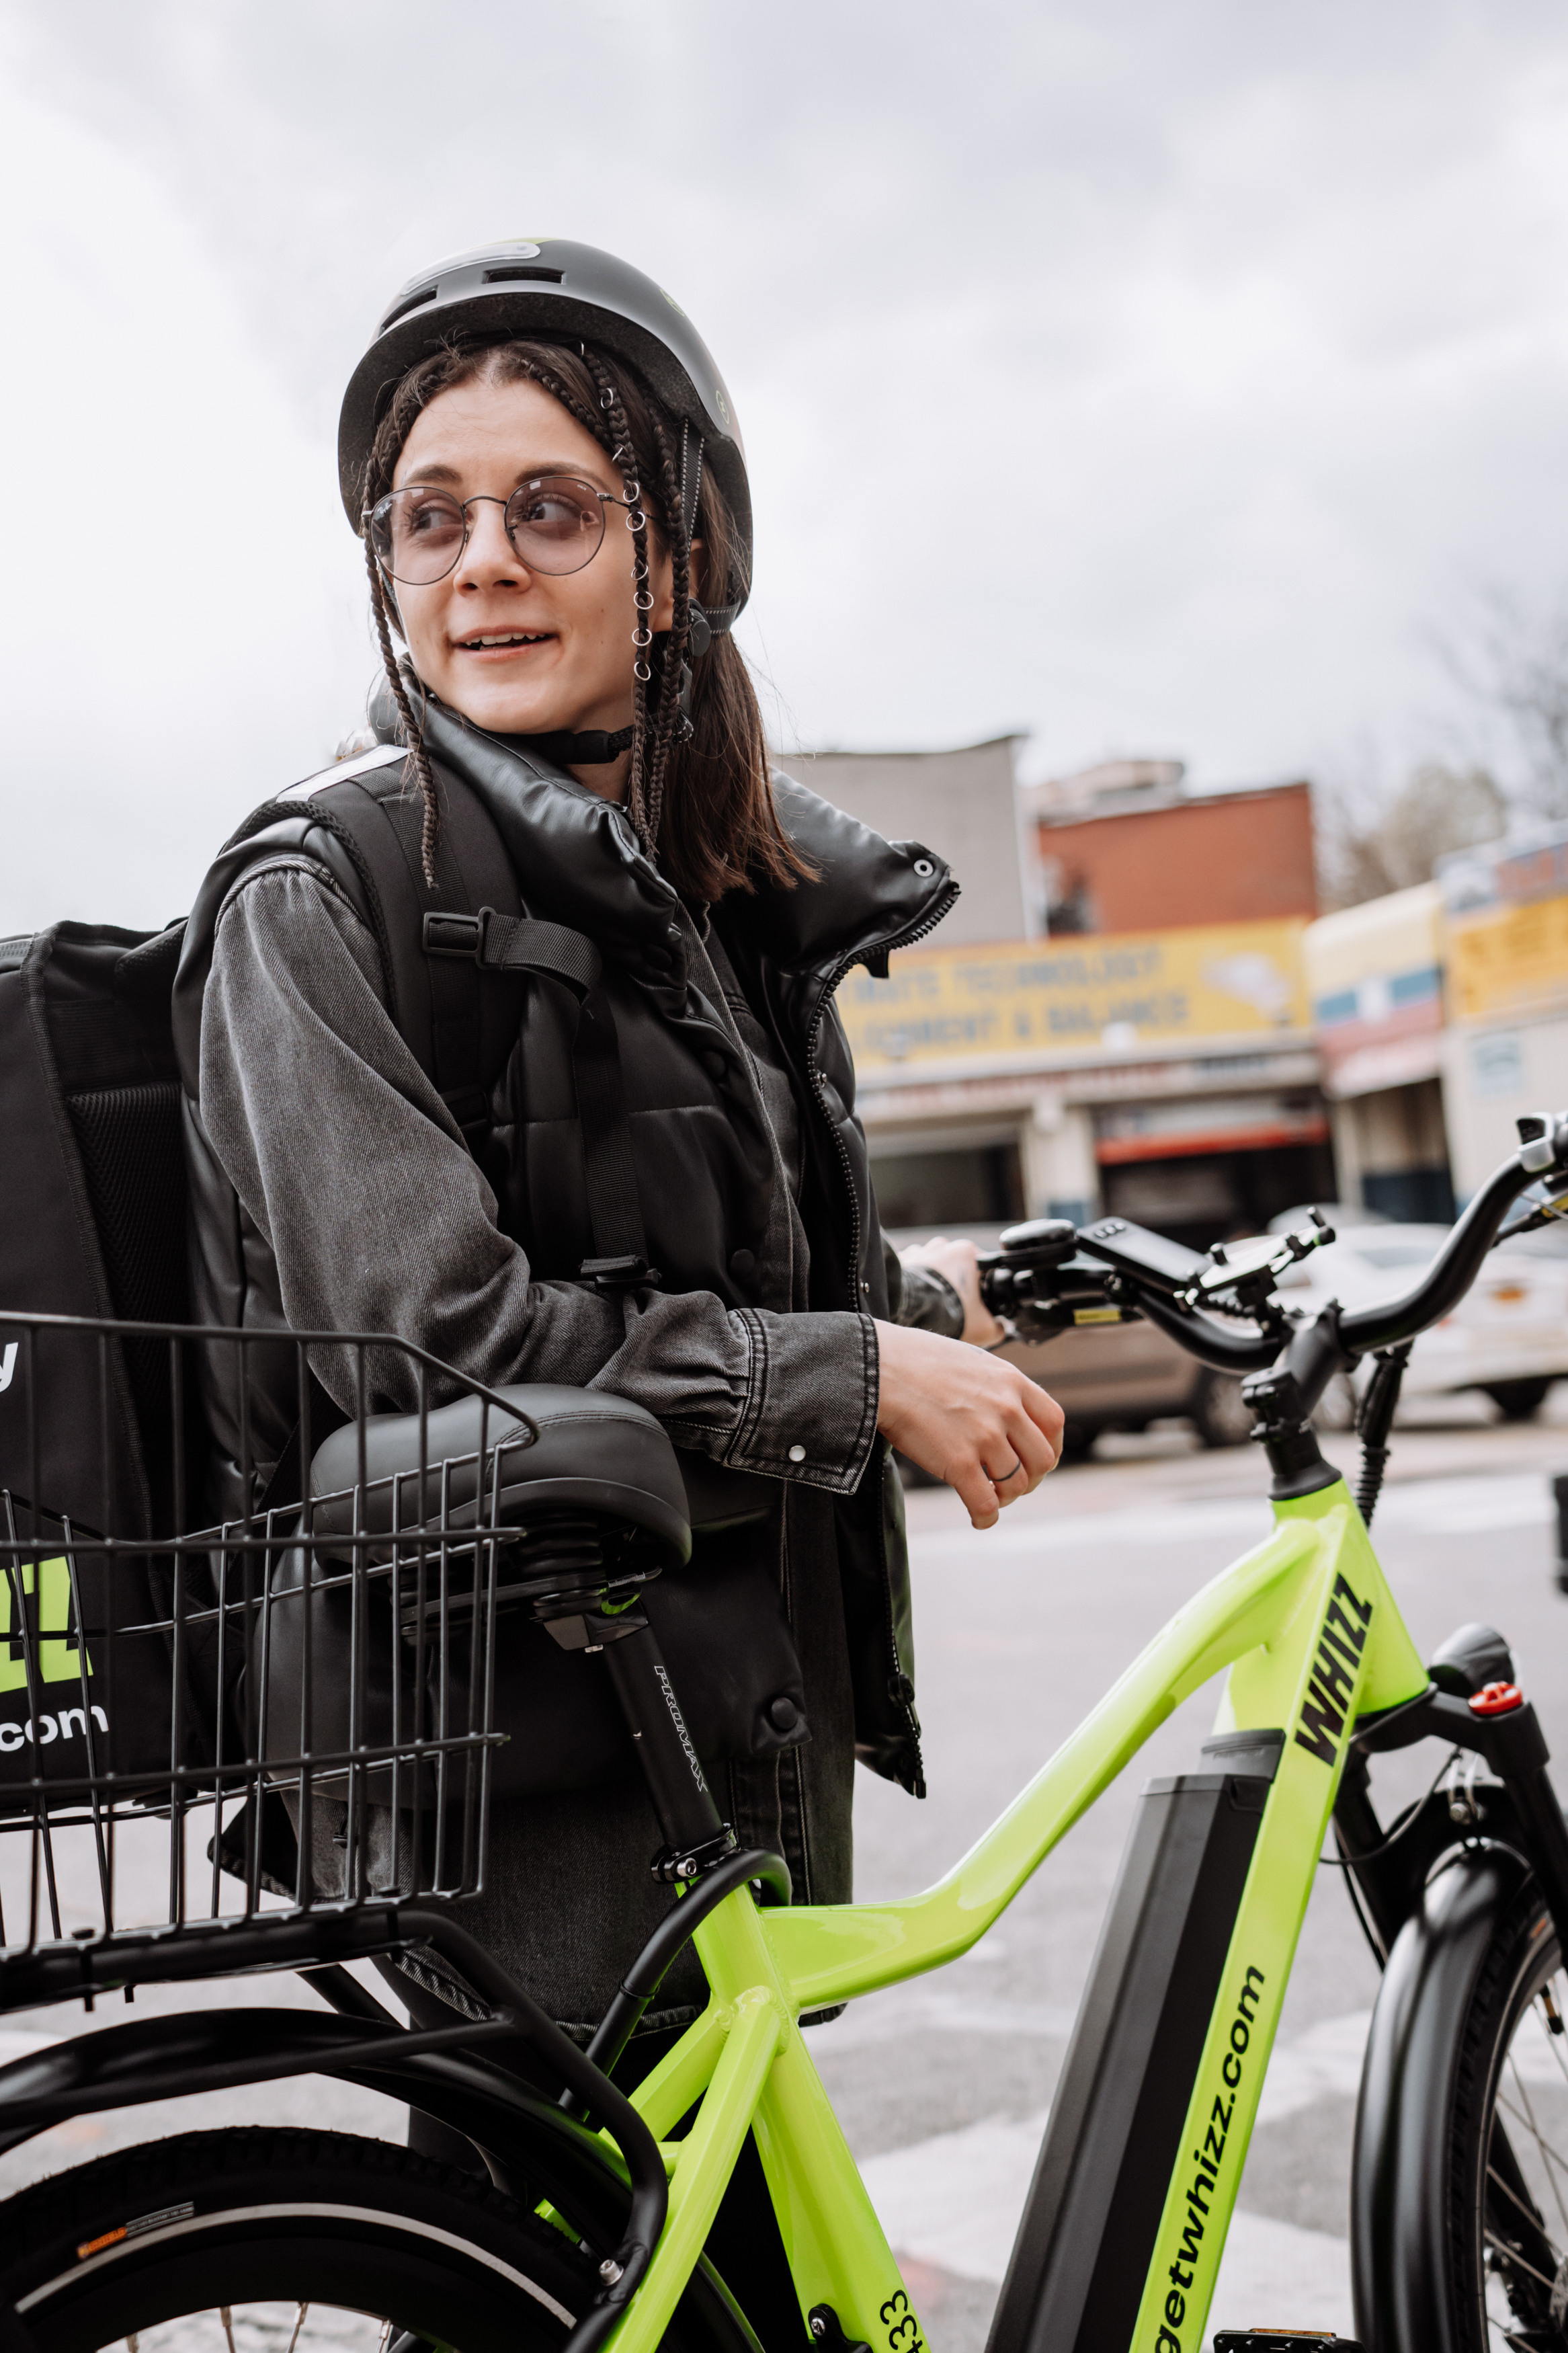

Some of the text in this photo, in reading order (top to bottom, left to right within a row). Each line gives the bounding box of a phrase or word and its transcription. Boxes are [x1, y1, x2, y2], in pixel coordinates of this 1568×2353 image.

[654, 1665, 708, 1792] PROMAX
[1294, 1571, 1373, 1767] WHIZZ
[1155, 1965, 1265, 2353] getwhizz.com
